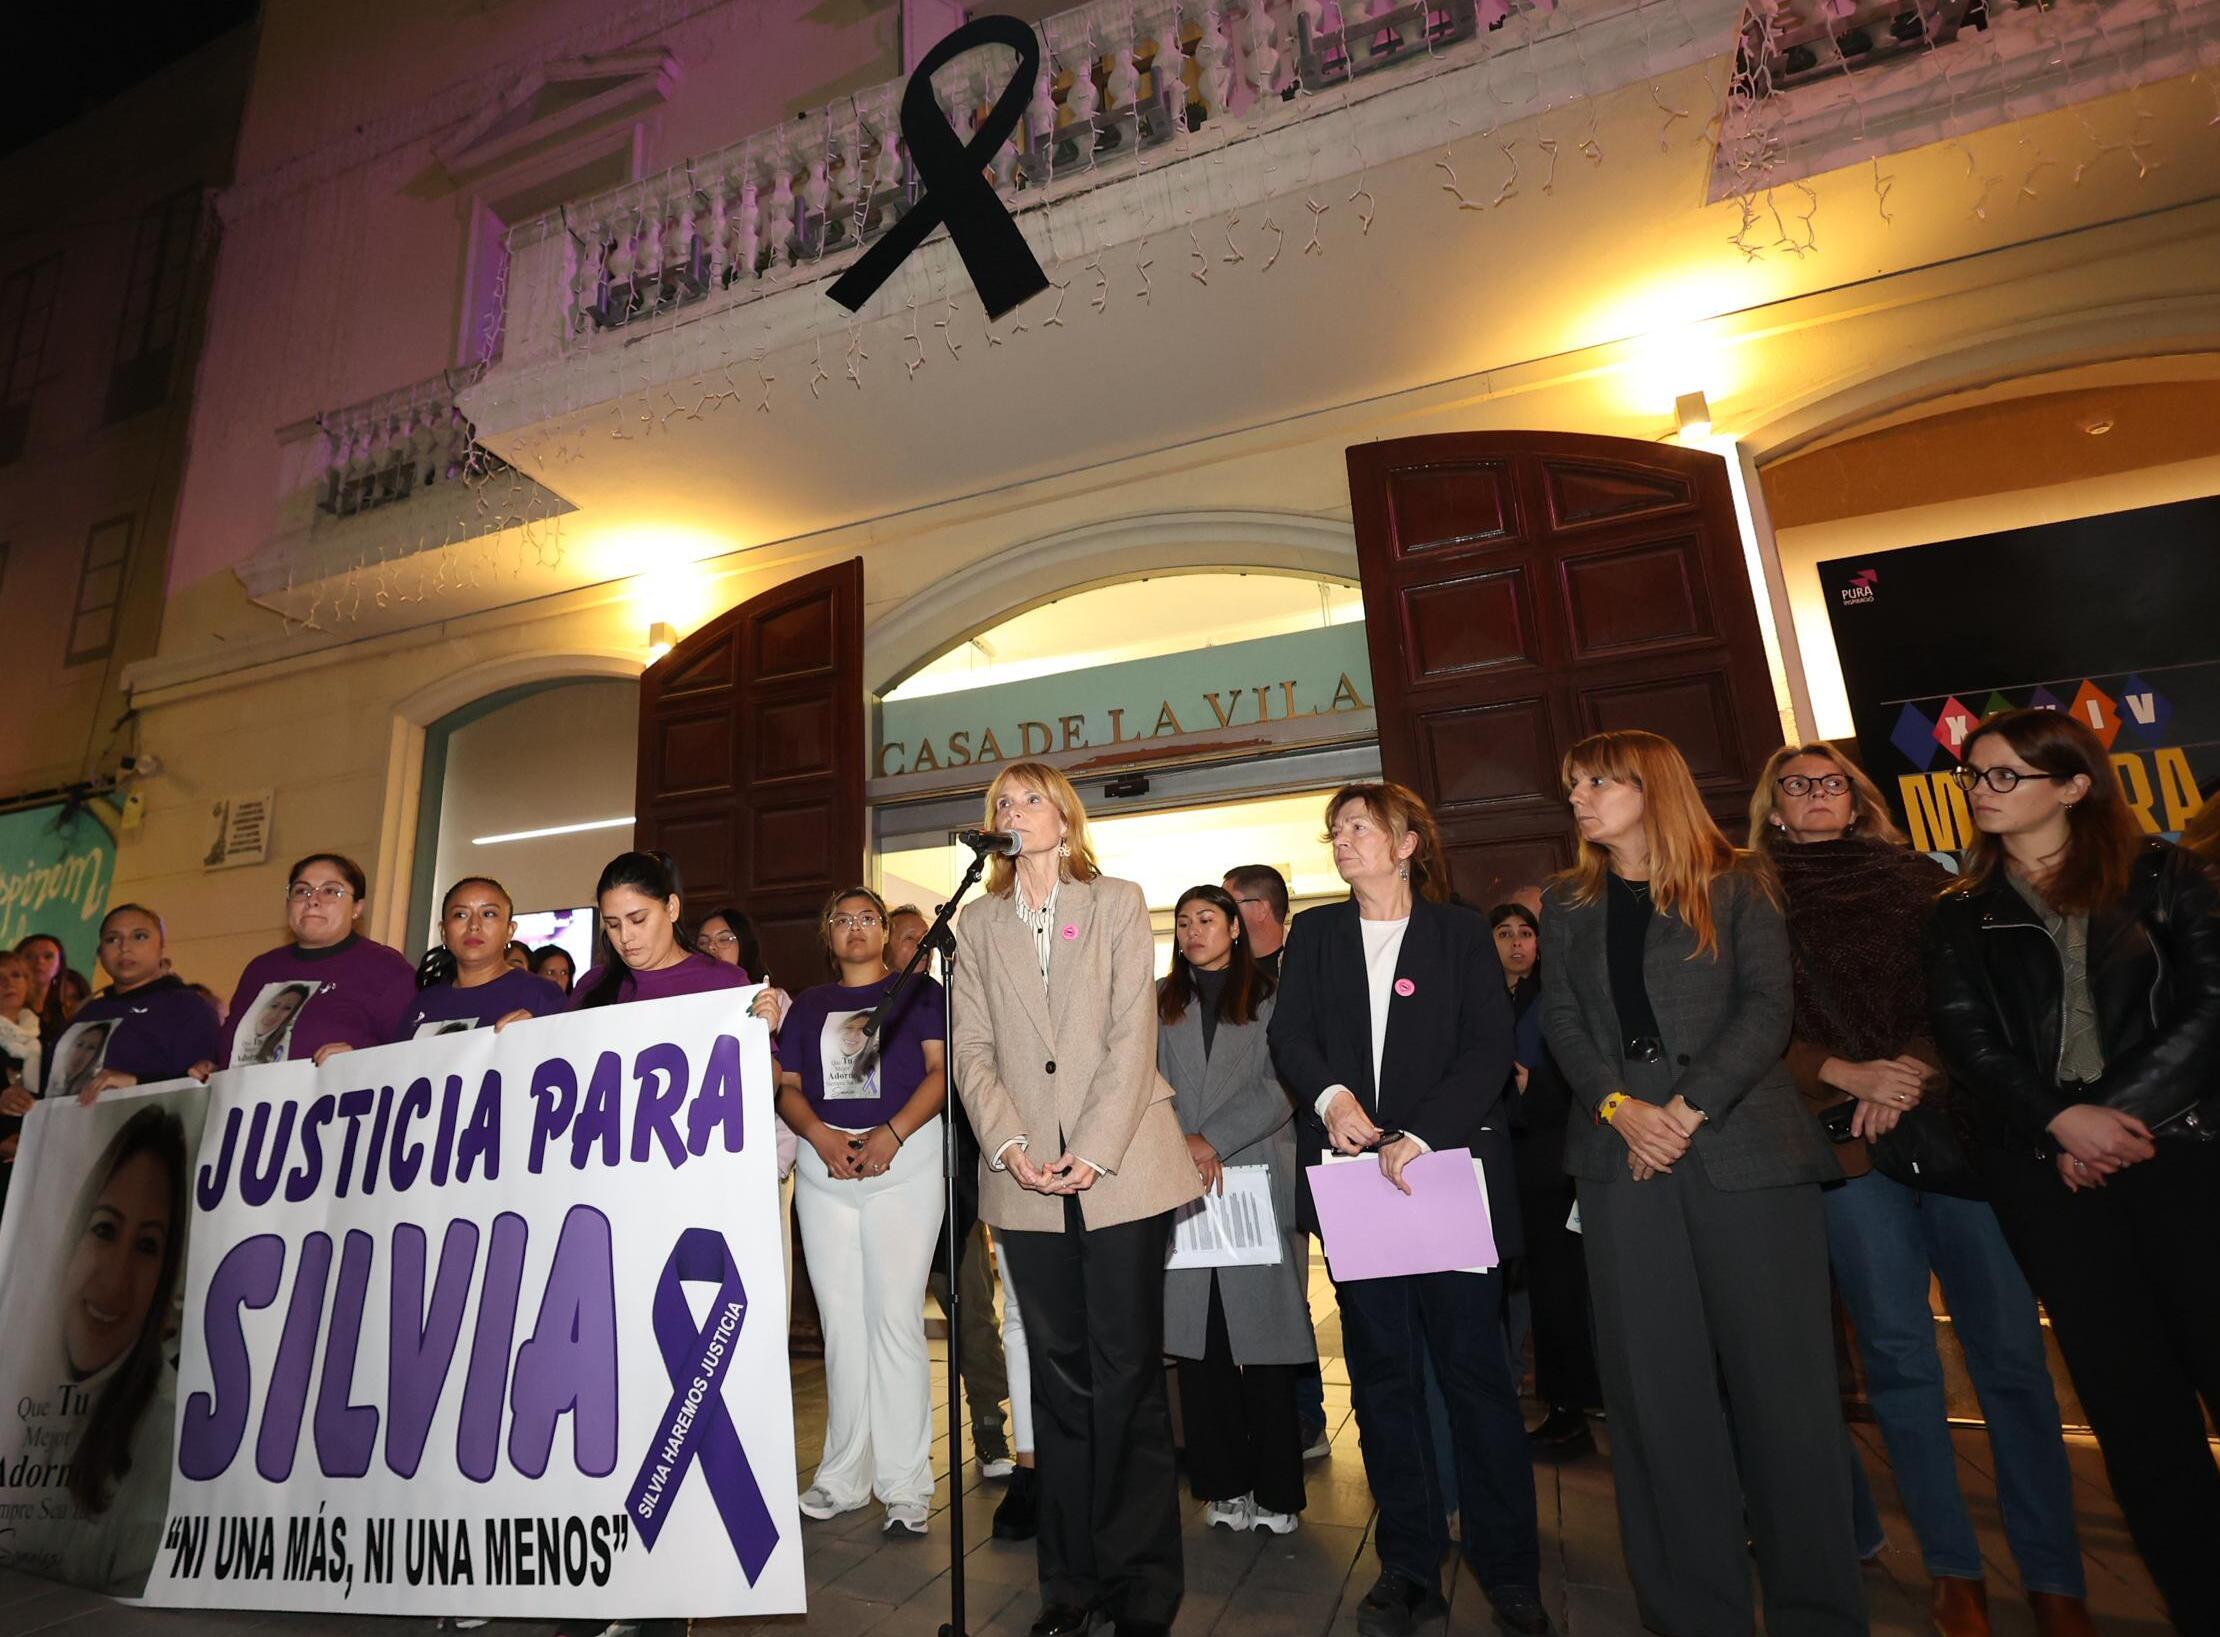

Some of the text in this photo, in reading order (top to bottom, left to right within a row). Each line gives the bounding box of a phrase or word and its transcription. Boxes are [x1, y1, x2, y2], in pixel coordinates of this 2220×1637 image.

[1841, 585, 1873, 601] PURA
[877, 672, 1373, 778] CASA DE LA VILA
[198, 1034, 744, 1212] JUSTICIA PARA
[179, 1204, 618, 1483] SILVIA
[17, 1384, 90, 1419] Que Tu
[638, 1301, 744, 1519] SILVIA HAREMOS JUSTICIA
[164, 1500, 629, 1600] “NI UNA MÁS, NI UNA MENOS”
